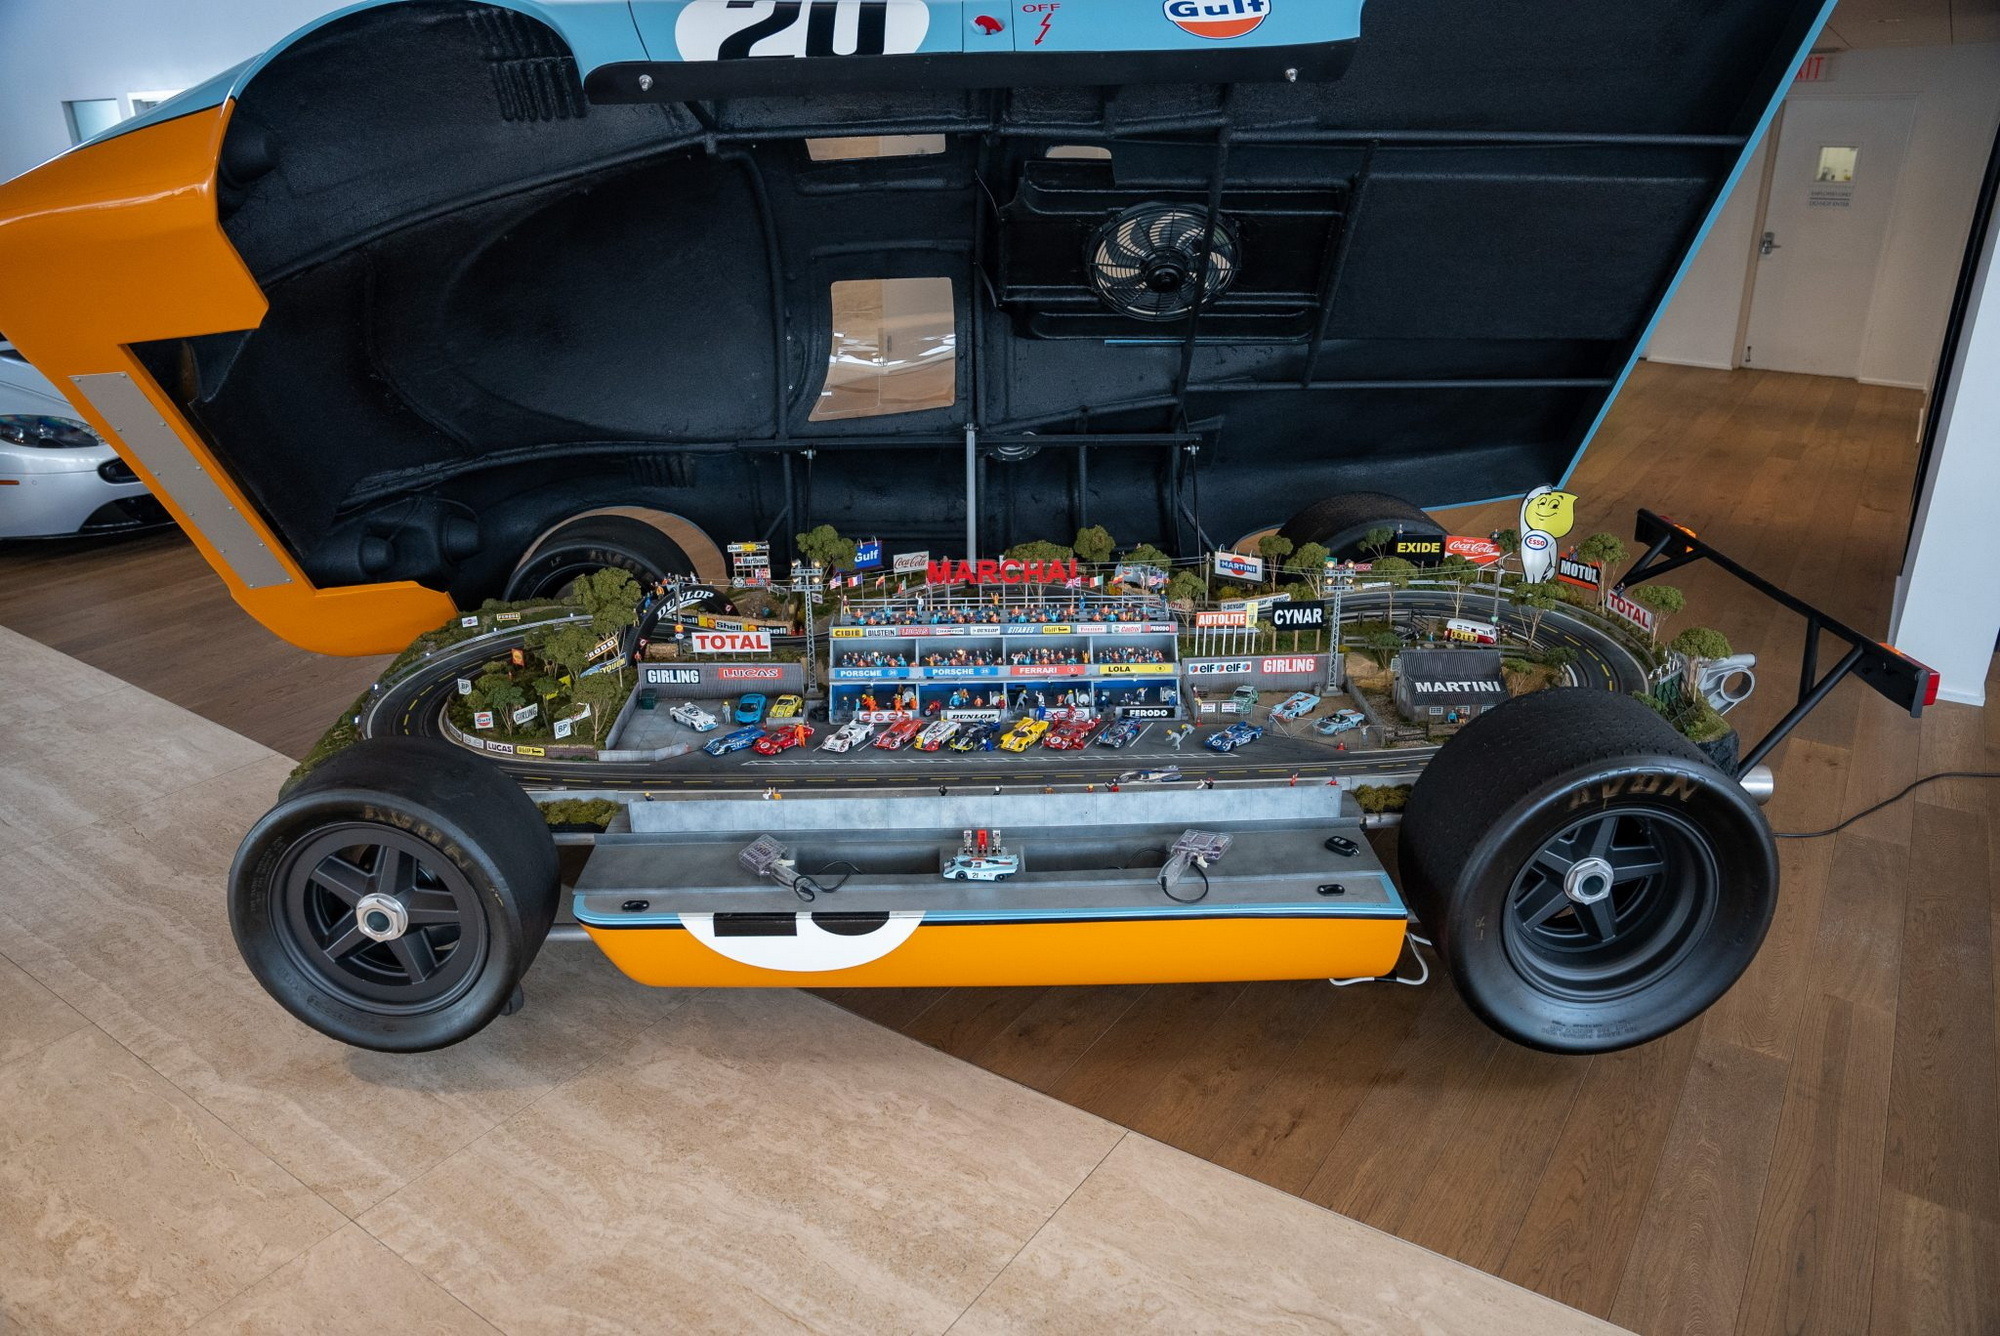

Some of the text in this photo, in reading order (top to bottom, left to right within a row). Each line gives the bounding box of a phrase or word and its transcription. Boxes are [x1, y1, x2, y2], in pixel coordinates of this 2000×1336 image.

[1022, 4, 1061, 13] OFF
[1169, 0, 1263, 17] Gulf
[1397, 542, 1441, 553] EXIDE
[854, 549, 879, 562] Gulf
[926, 557, 1091, 584] MARCHAL
[1221, 561, 1257, 573] MARTINI
[1560, 560, 1599, 584] MOTUL
[657, 590, 715, 621] DUNLOP
[1608, 593, 1650, 629] TOTAL
[1197, 613, 1246, 625] AUTOLITE
[1273, 608, 1323, 625] CYNAR
[716, 621, 742, 631] Shell
[758, 626, 787, 634] Shell
[867, 629, 895, 637] BILSTEIN
[695, 634, 769, 650] TOTAL
[1451, 629, 1477, 642] SOLEX
[932, 668, 975, 676] PORSCHE
[1199, 662, 1241, 673] elf elf
[1262, 657, 1316, 674] GIRLING
[647, 668, 700, 684] GIRLING
[722, 668, 780, 678] LUCAS
[1414, 681, 1501, 693] MARTINI
[515, 706, 538, 720] GIRLING
[1129, 708, 1169, 718] FERODO
[487, 740, 513, 753] LUCAS
[1567, 772, 1700, 812] AVON
